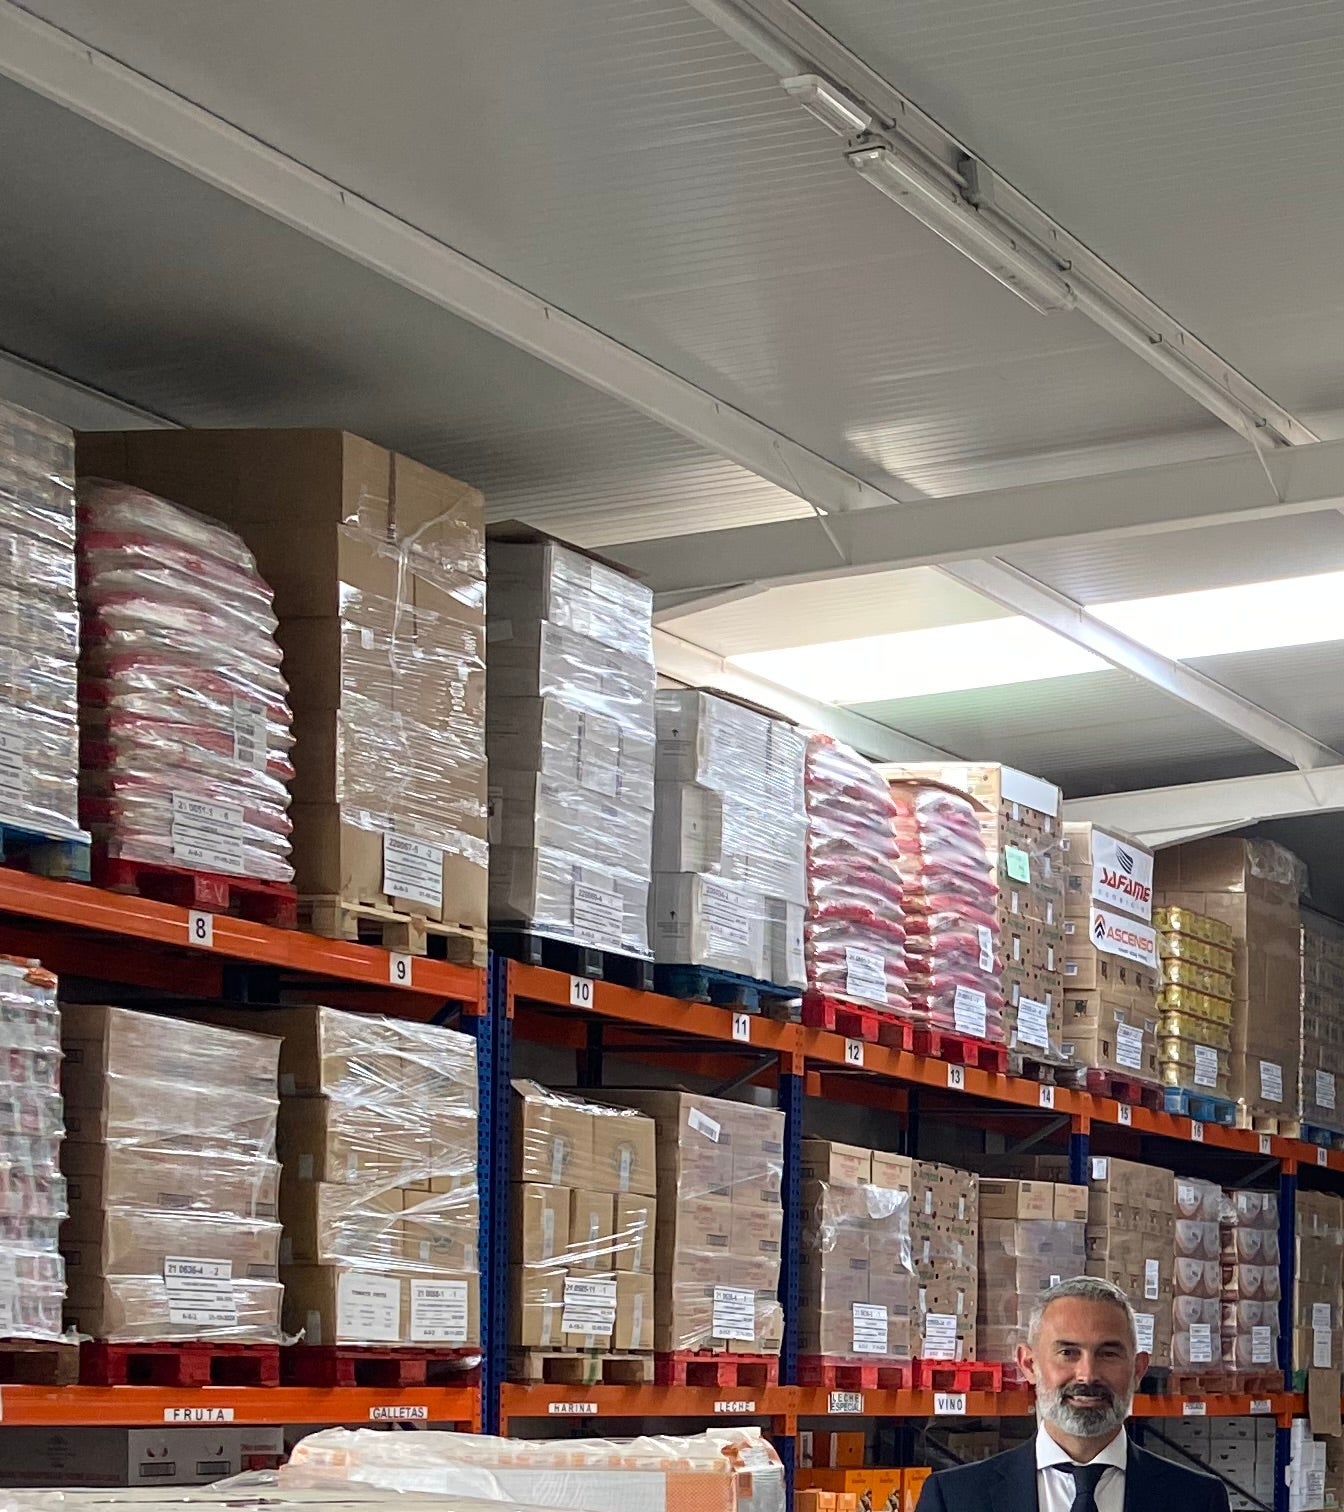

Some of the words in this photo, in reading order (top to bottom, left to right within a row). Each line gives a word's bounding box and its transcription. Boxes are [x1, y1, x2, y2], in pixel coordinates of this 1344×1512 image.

[195, 918, 206, 940] 8
[1106, 926, 1154, 954] ASCENSO
[397, 960, 405, 980] 9
[574, 981, 590, 1000] 10
[735, 1018, 747, 1035] 11
[848, 1044, 860, 1060] 12
[950, 1068, 960, 1084] 13
[1042, 1090, 1051, 1102] 14
[1120, 1108, 1128, 1120] 15
[832, 1394, 859, 1402] LECHE
[938, 1398, 963, 1410] VINO
[372, 1407, 424, 1420] GALLETAS
[554, 1404, 591, 1412] HARINA
[719, 1402, 750, 1412] LECHE
[173, 1408, 225, 1420] FRUTA
